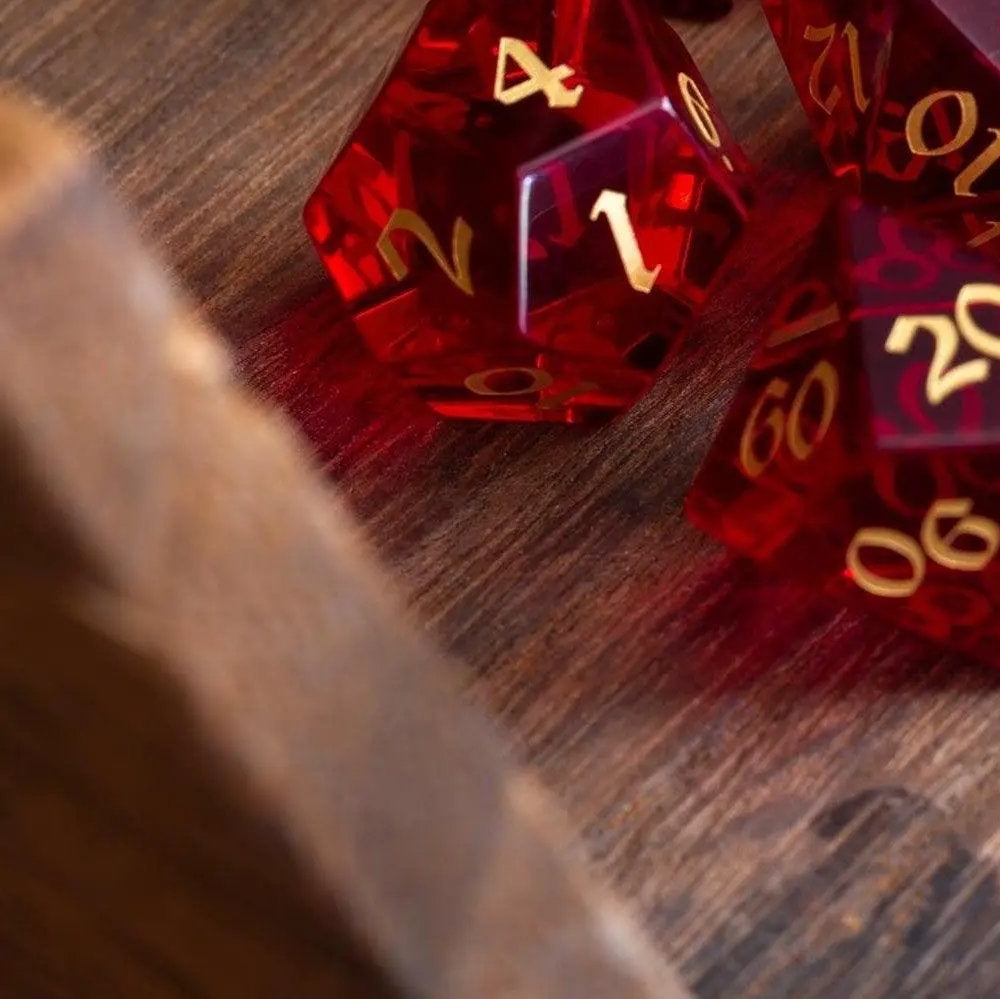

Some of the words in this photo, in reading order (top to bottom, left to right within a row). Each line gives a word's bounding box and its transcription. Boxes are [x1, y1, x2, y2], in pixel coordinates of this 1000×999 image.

[494, 37, 583, 109] 4
[375, 208, 475, 296] 2
[590, 189, 662, 294] 1
[739, 361, 840, 478] 60
